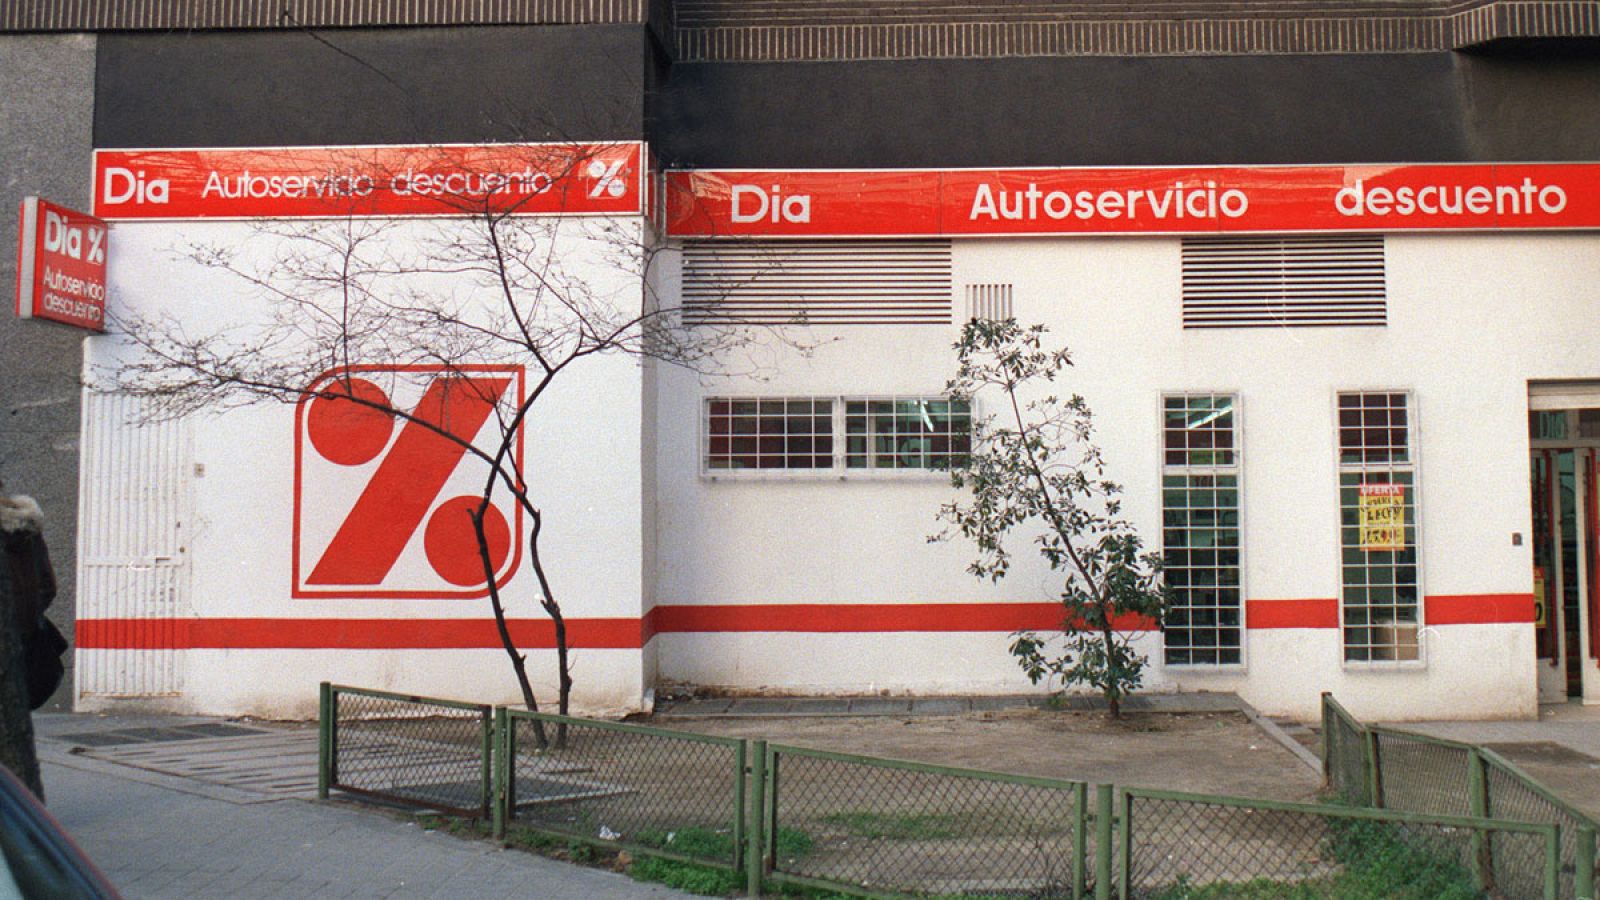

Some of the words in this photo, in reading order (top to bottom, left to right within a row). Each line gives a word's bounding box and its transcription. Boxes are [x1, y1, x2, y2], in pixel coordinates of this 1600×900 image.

[103, 166, 170, 205] Dia
[201, 167, 375, 199] Autoservicio
[390, 166, 553, 197] descuento
[731, 184, 811, 225] Dia
[968, 179, 1249, 222] Autoservicio
[1334, 176, 1568, 217] descuento
[44, 208, 82, 260] Dia
[44, 264, 105, 301] Autoservicio
[43, 292, 101, 321] descuento
